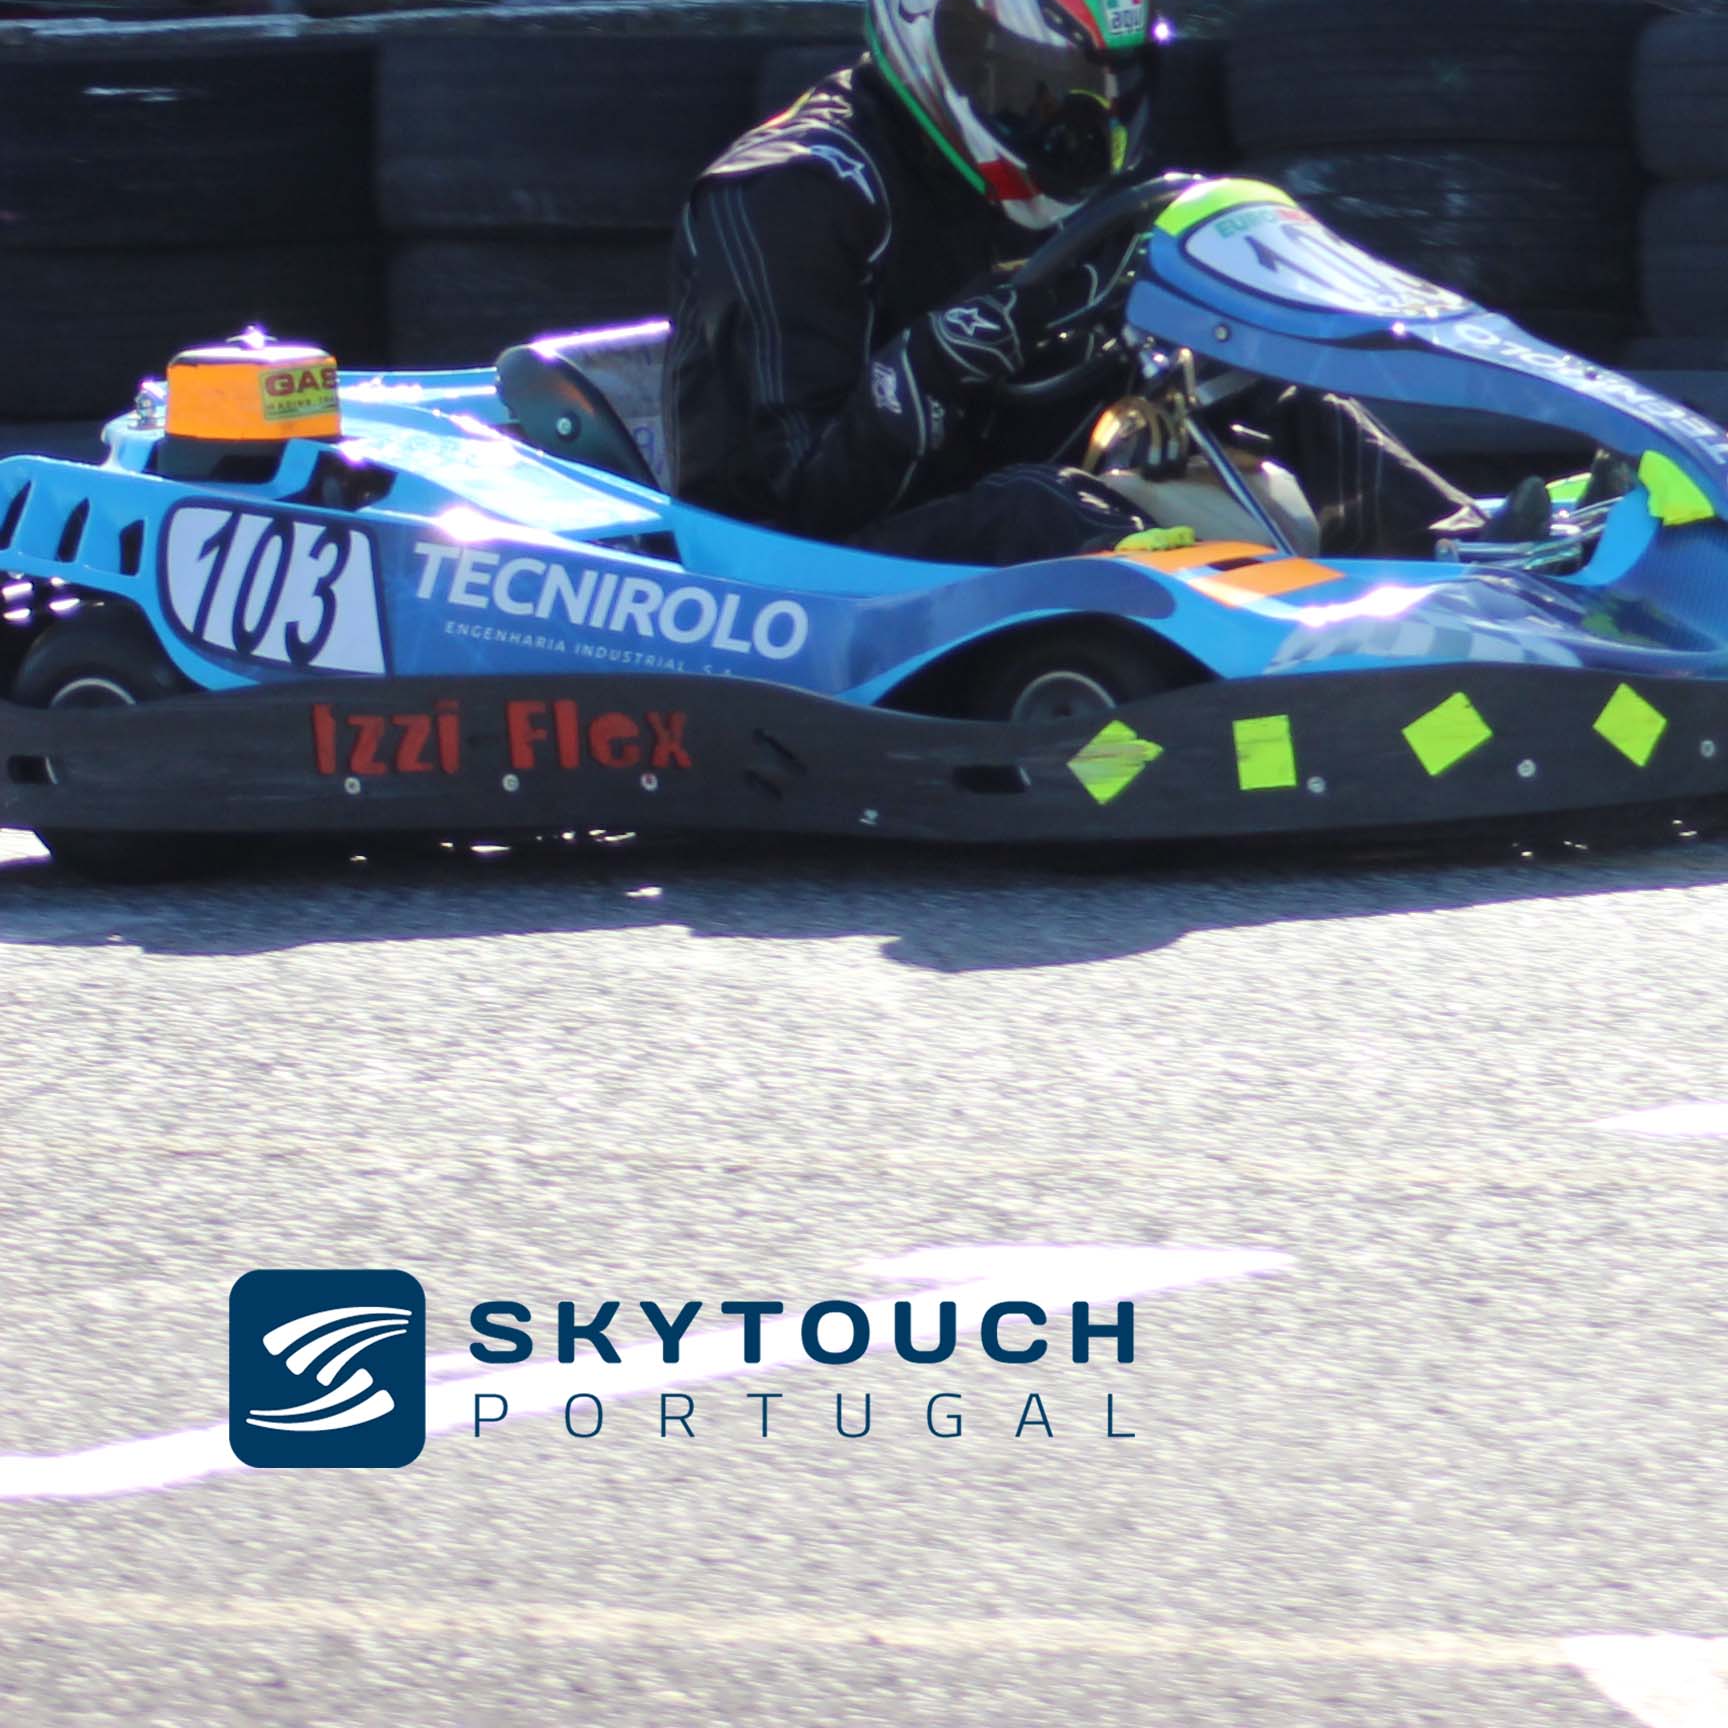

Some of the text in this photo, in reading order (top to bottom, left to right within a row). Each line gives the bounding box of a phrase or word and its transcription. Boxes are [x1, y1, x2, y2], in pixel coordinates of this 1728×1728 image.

[199, 508, 351, 663] 103
[413, 541, 809, 660] TECNIROLO
[444, 621, 566, 653] ENGENHARIA
[311, 699, 693, 775] Izzi Flex
